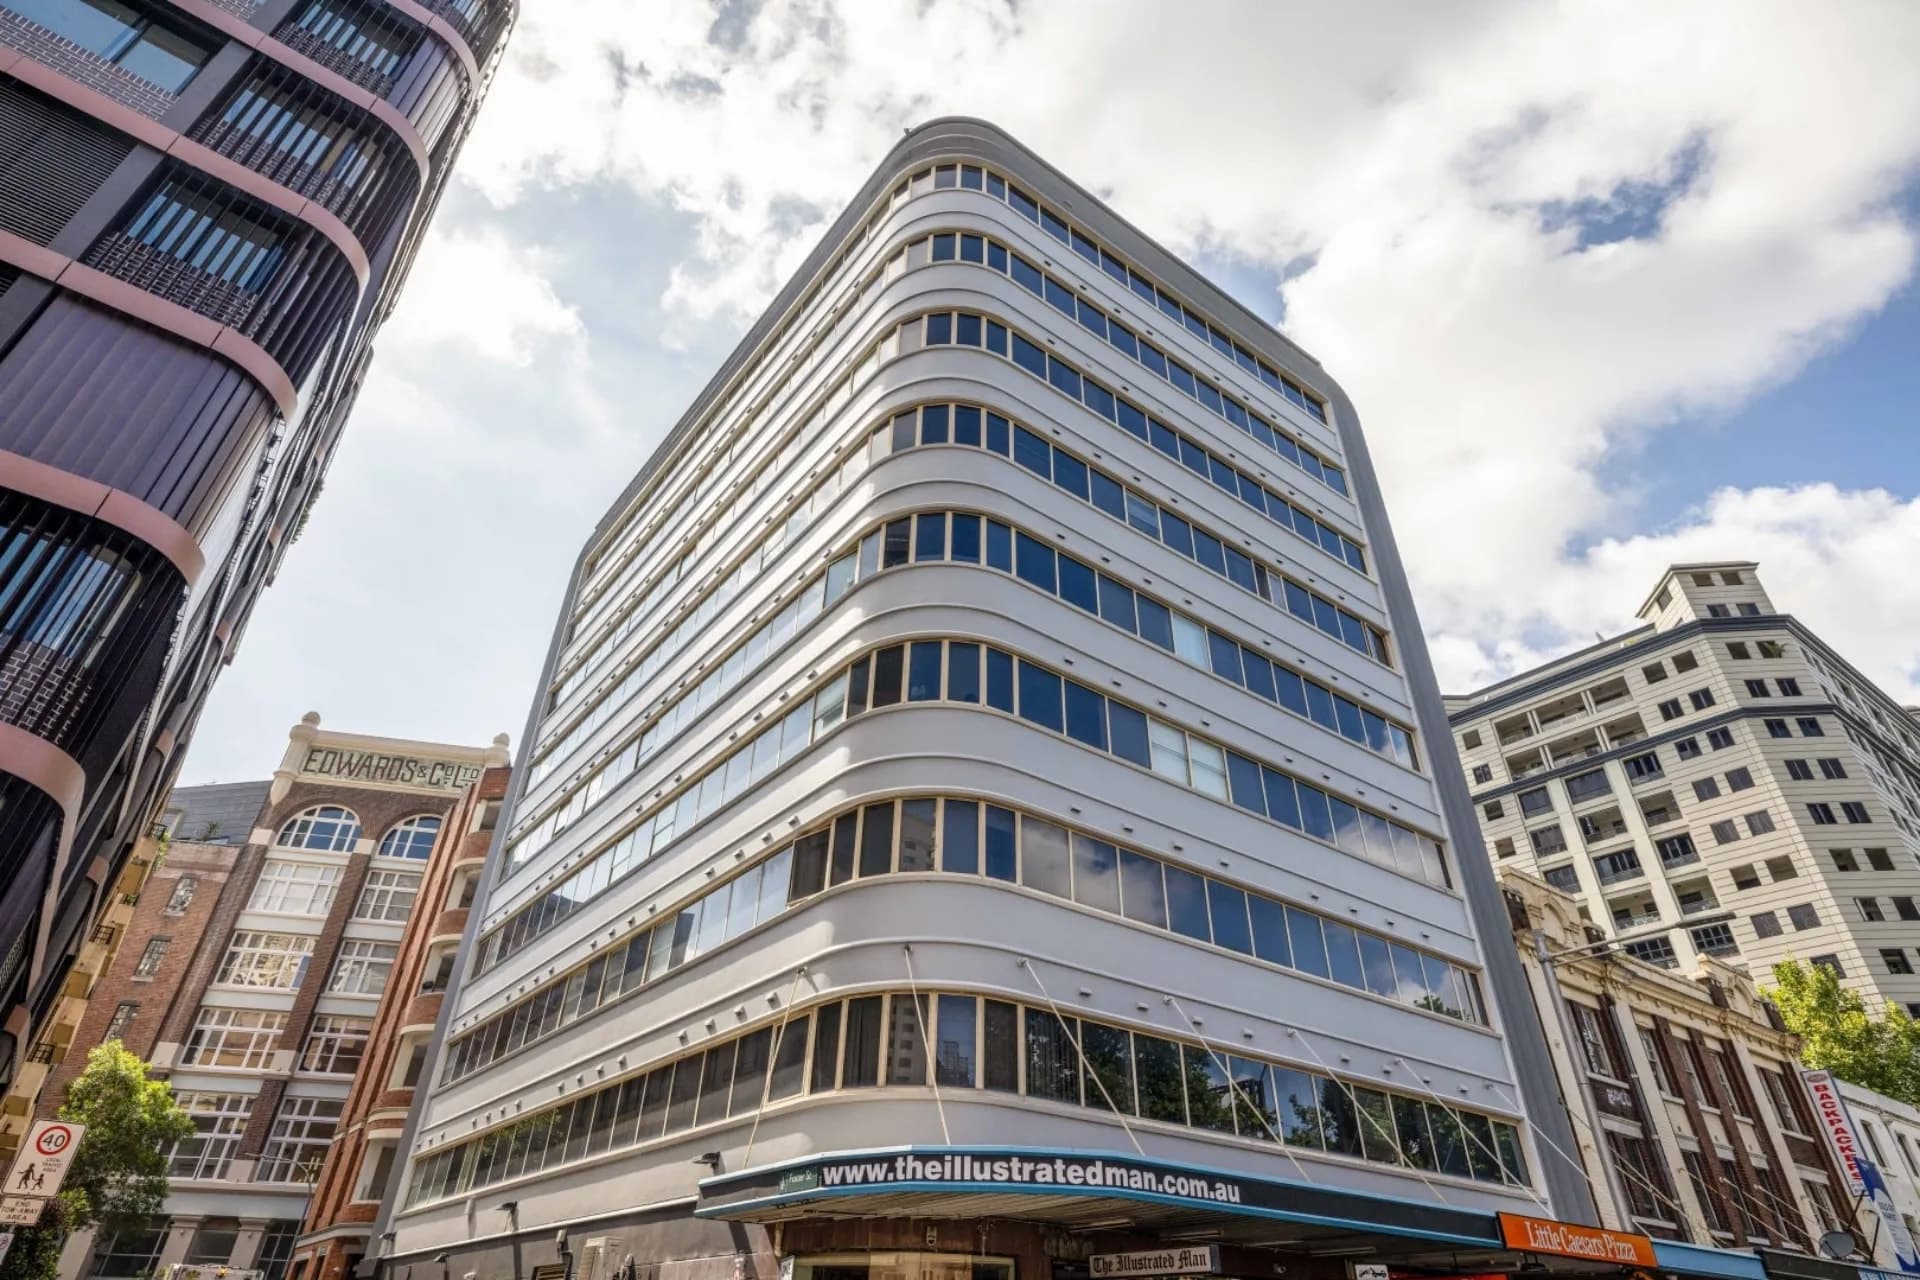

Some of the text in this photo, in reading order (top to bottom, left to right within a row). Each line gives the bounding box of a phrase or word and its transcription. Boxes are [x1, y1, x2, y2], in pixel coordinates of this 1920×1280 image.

[303, 748, 418, 783] EDWARDS
[417, 765, 427, 778] &
[43, 1134, 66, 1148] 40
[822, 1155, 1241, 1203] www.theillustratedman.com.au
[1524, 1221, 1638, 1262] Little Caesars Pizza
[1093, 1249, 1208, 1275] The Illustrated Man
